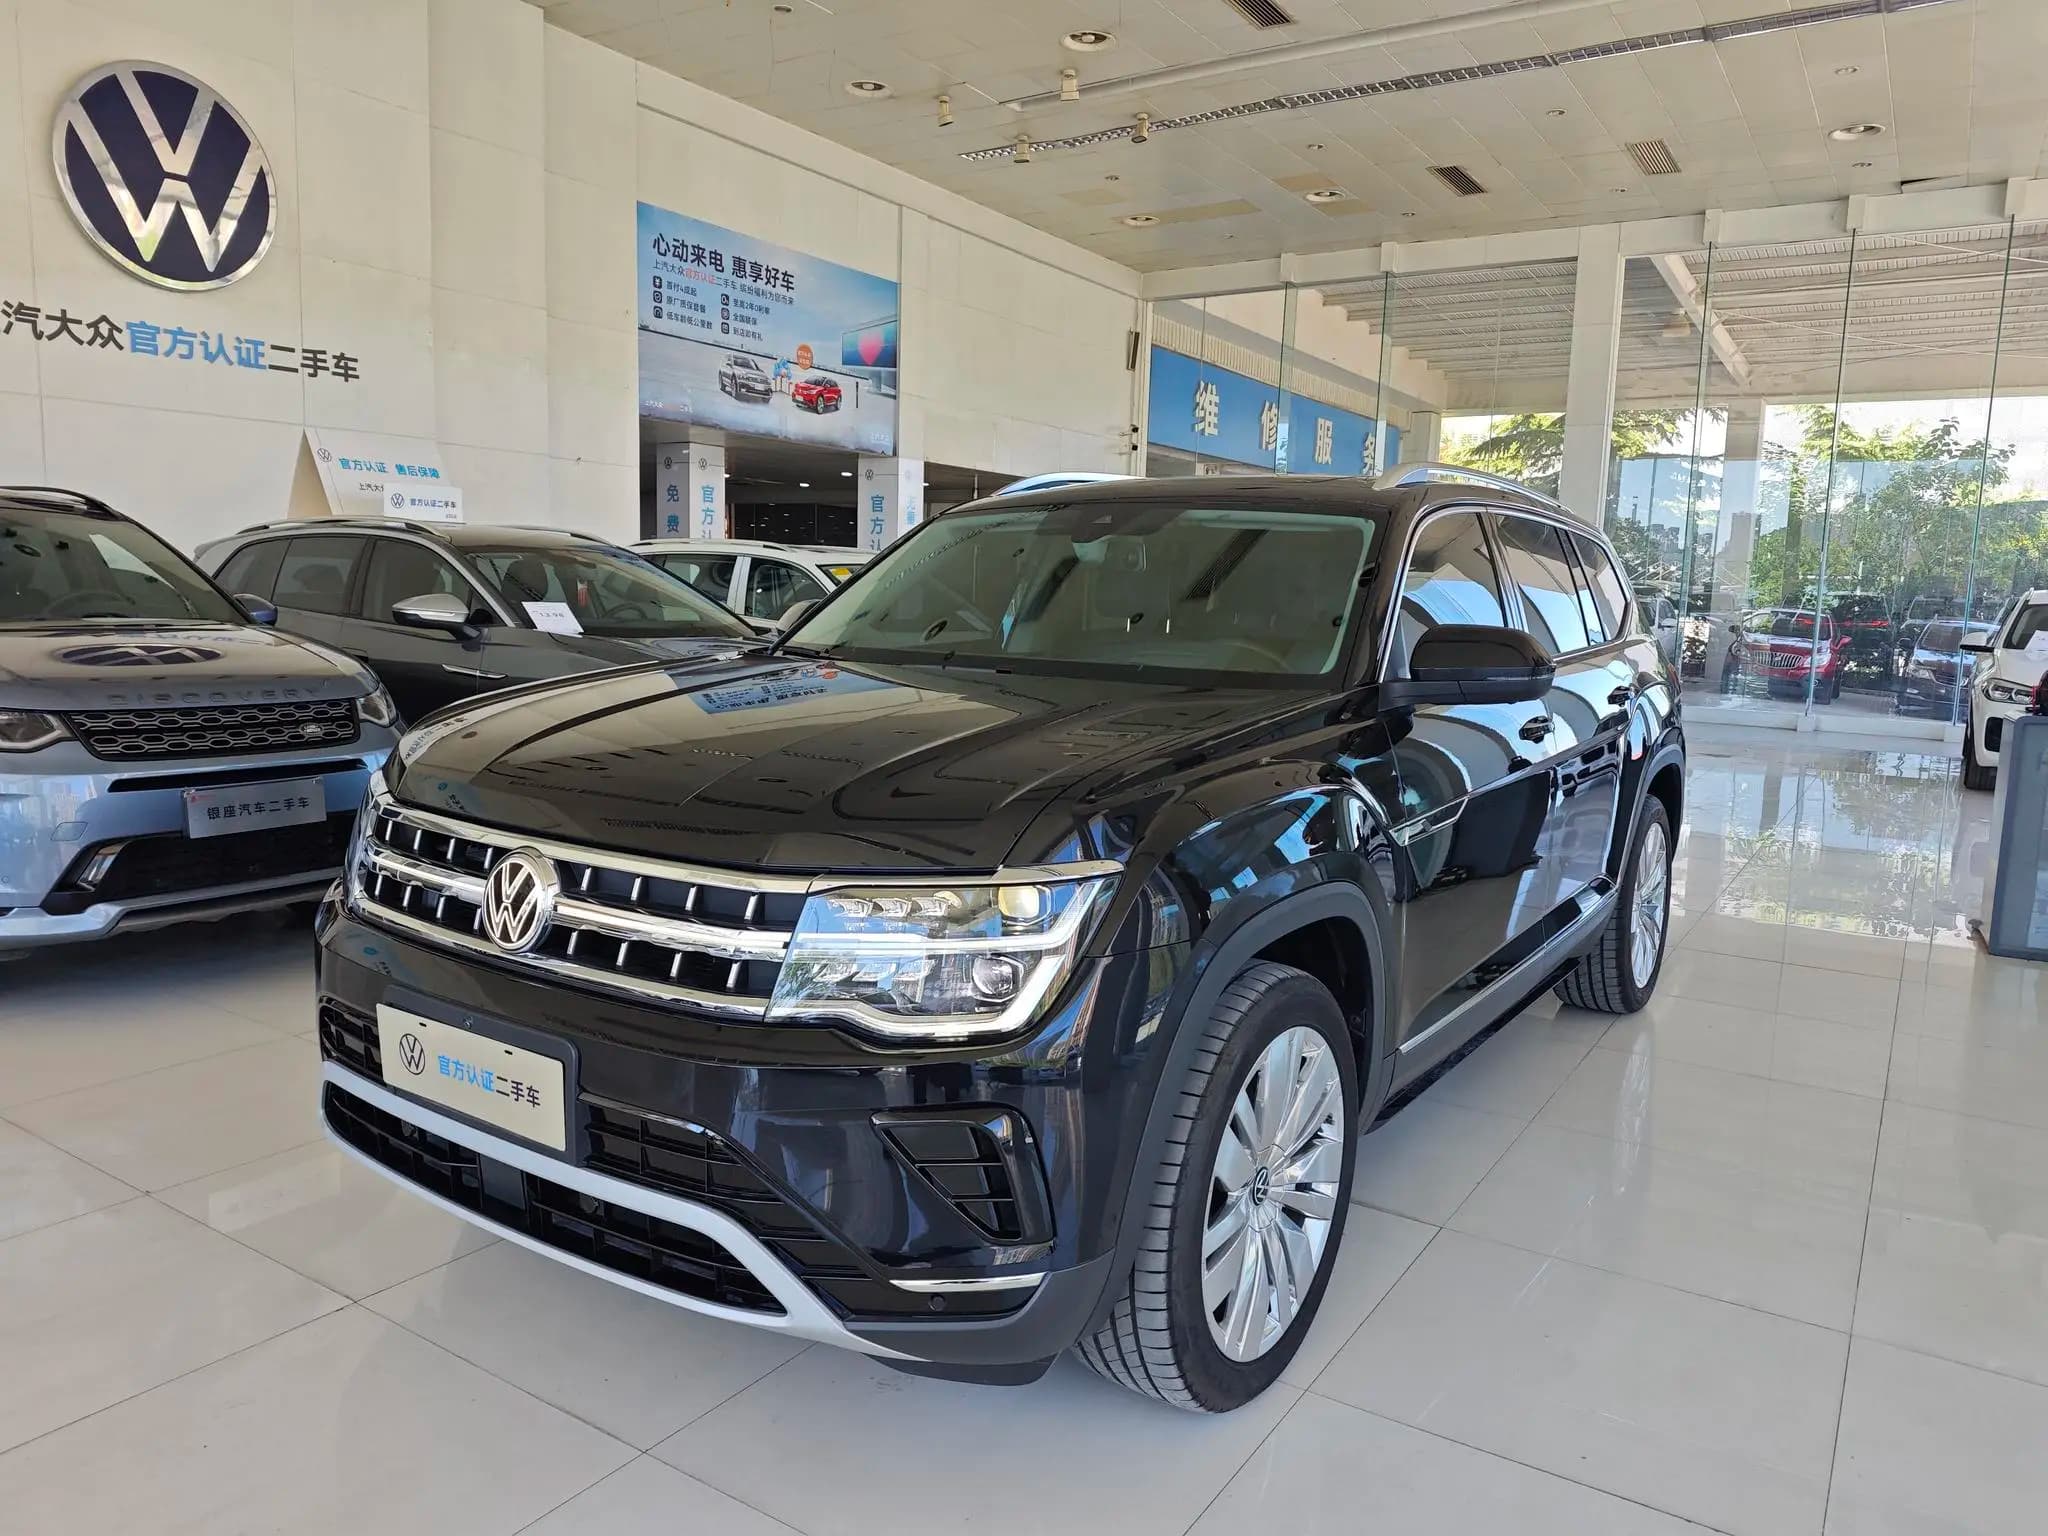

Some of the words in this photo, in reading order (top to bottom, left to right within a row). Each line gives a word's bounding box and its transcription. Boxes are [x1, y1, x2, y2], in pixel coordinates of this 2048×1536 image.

[652, 232, 725, 273] 心动来电
[731, 255, 795, 292] 惠享好车
[1, 301, 360, 382] 汽大众官方认证二手车
[338, 457, 389, 475] 官方认证
[395, 463, 441, 480] 售后保障
[410, 497, 457, 510] 官方认证二手车
[107, 686, 322, 706] DISCOVERY
[207, 796, 310, 821] 银座汽车二手车
[437, 1054, 541, 1108] 官方认证二手车
